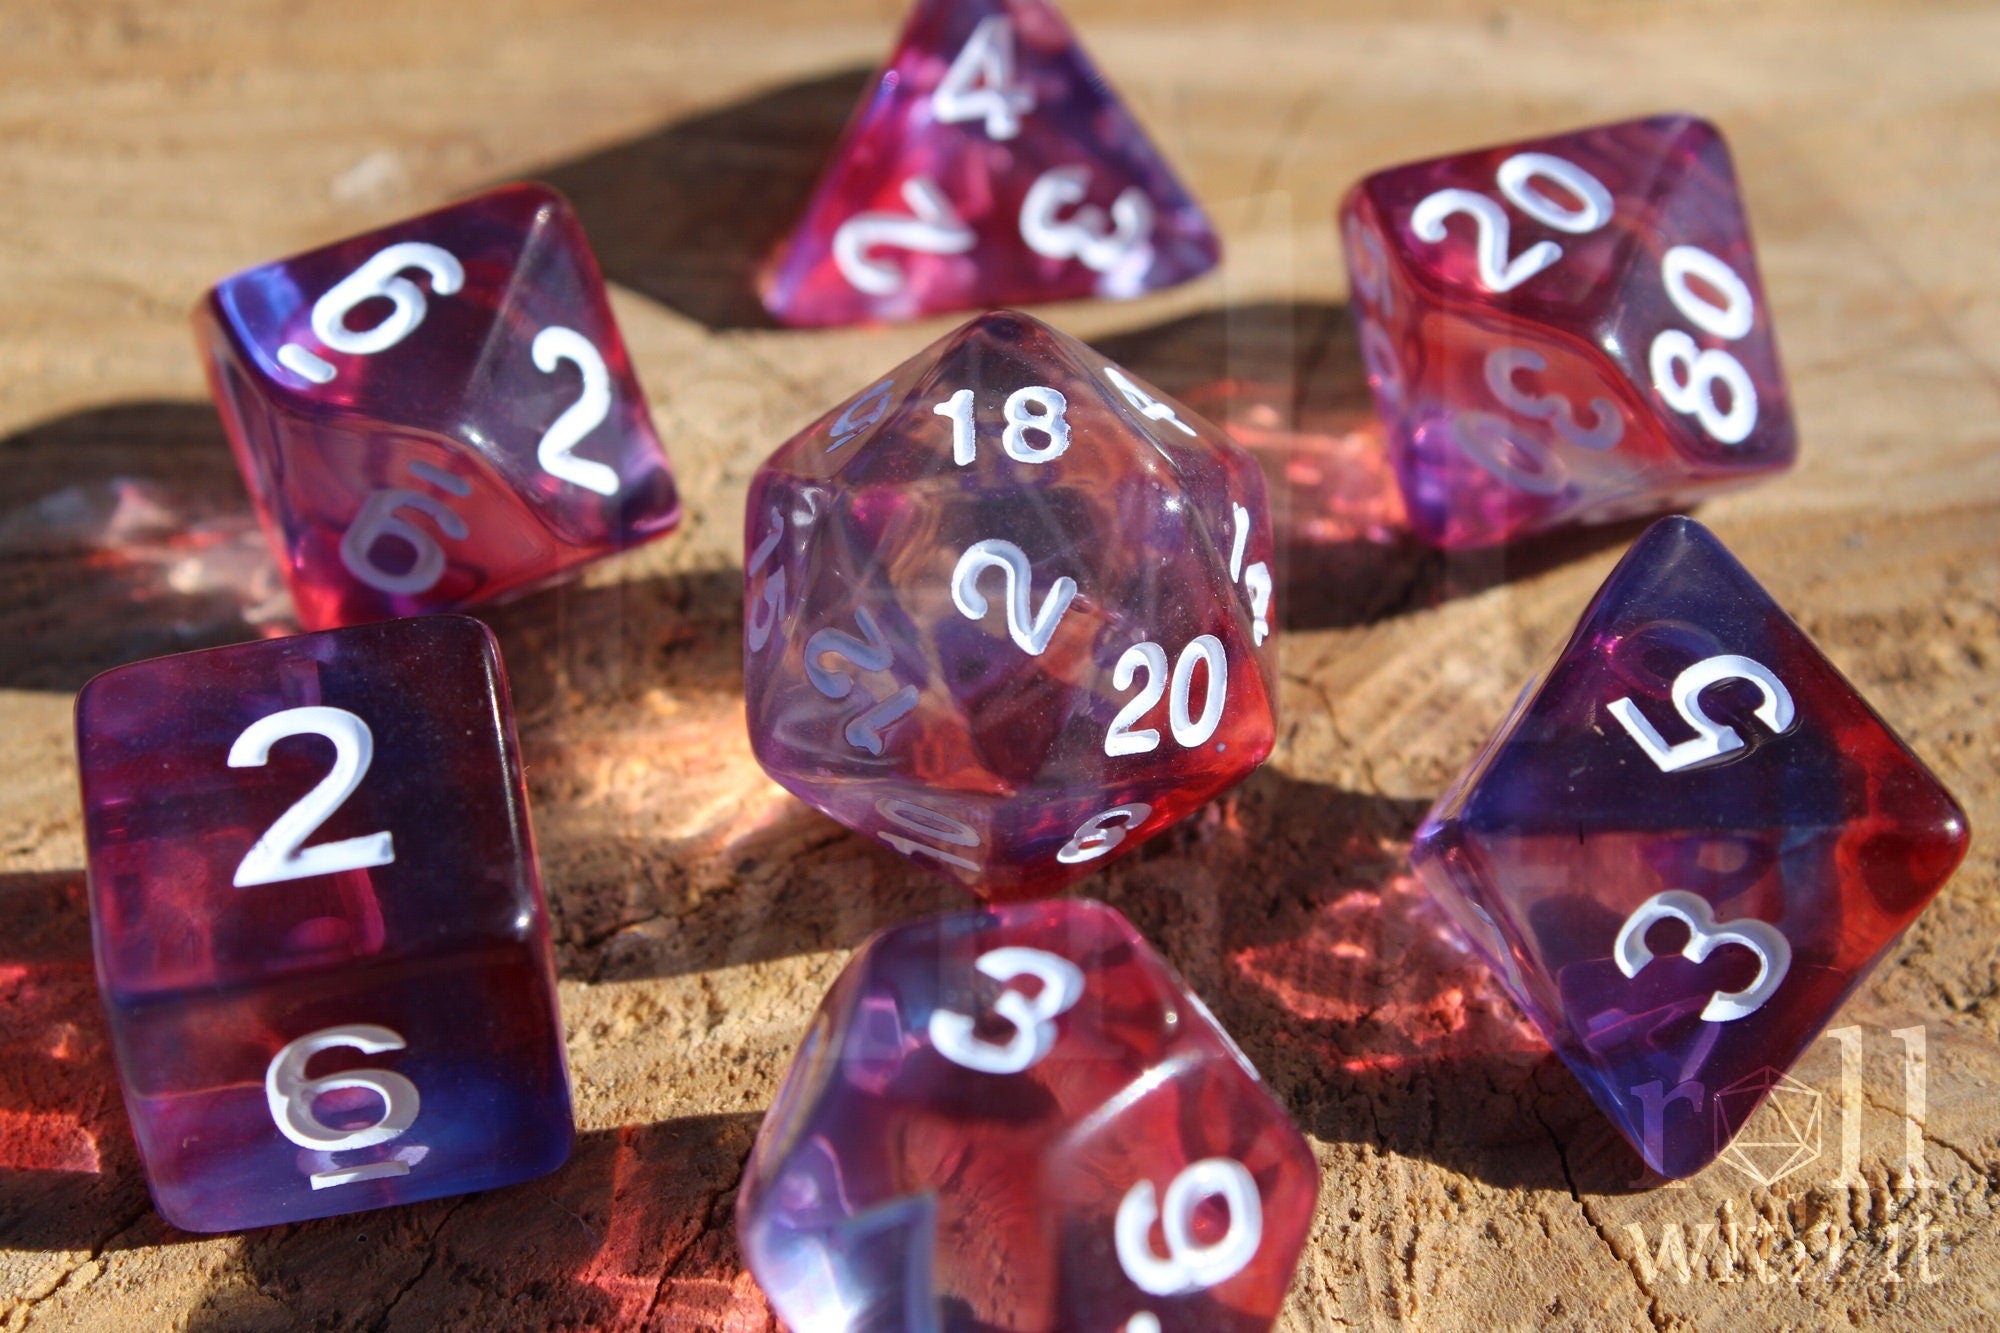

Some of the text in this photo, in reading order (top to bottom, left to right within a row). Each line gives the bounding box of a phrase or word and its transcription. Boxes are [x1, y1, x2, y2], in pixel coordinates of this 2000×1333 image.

[933, 14, 1034, 140] 4
[833, 177, 976, 296] 2
[1019, 164, 1155, 300] 3
[1411, 152, 1614, 293] 20
[1649, 245, 1758, 445] 80
[531, 326, 620, 496] 2
[933, 385, 1072, 466] 18
[951, 538, 1078, 656] 2
[1104, 634, 1228, 758] 20
[1606, 654, 1796, 773] 5
[226, 706, 395, 888] 2
[929, 946, 1085, 1074] 3
[1613, 889, 1793, 1022] 3
[265, 1023, 421, 1152] 6
